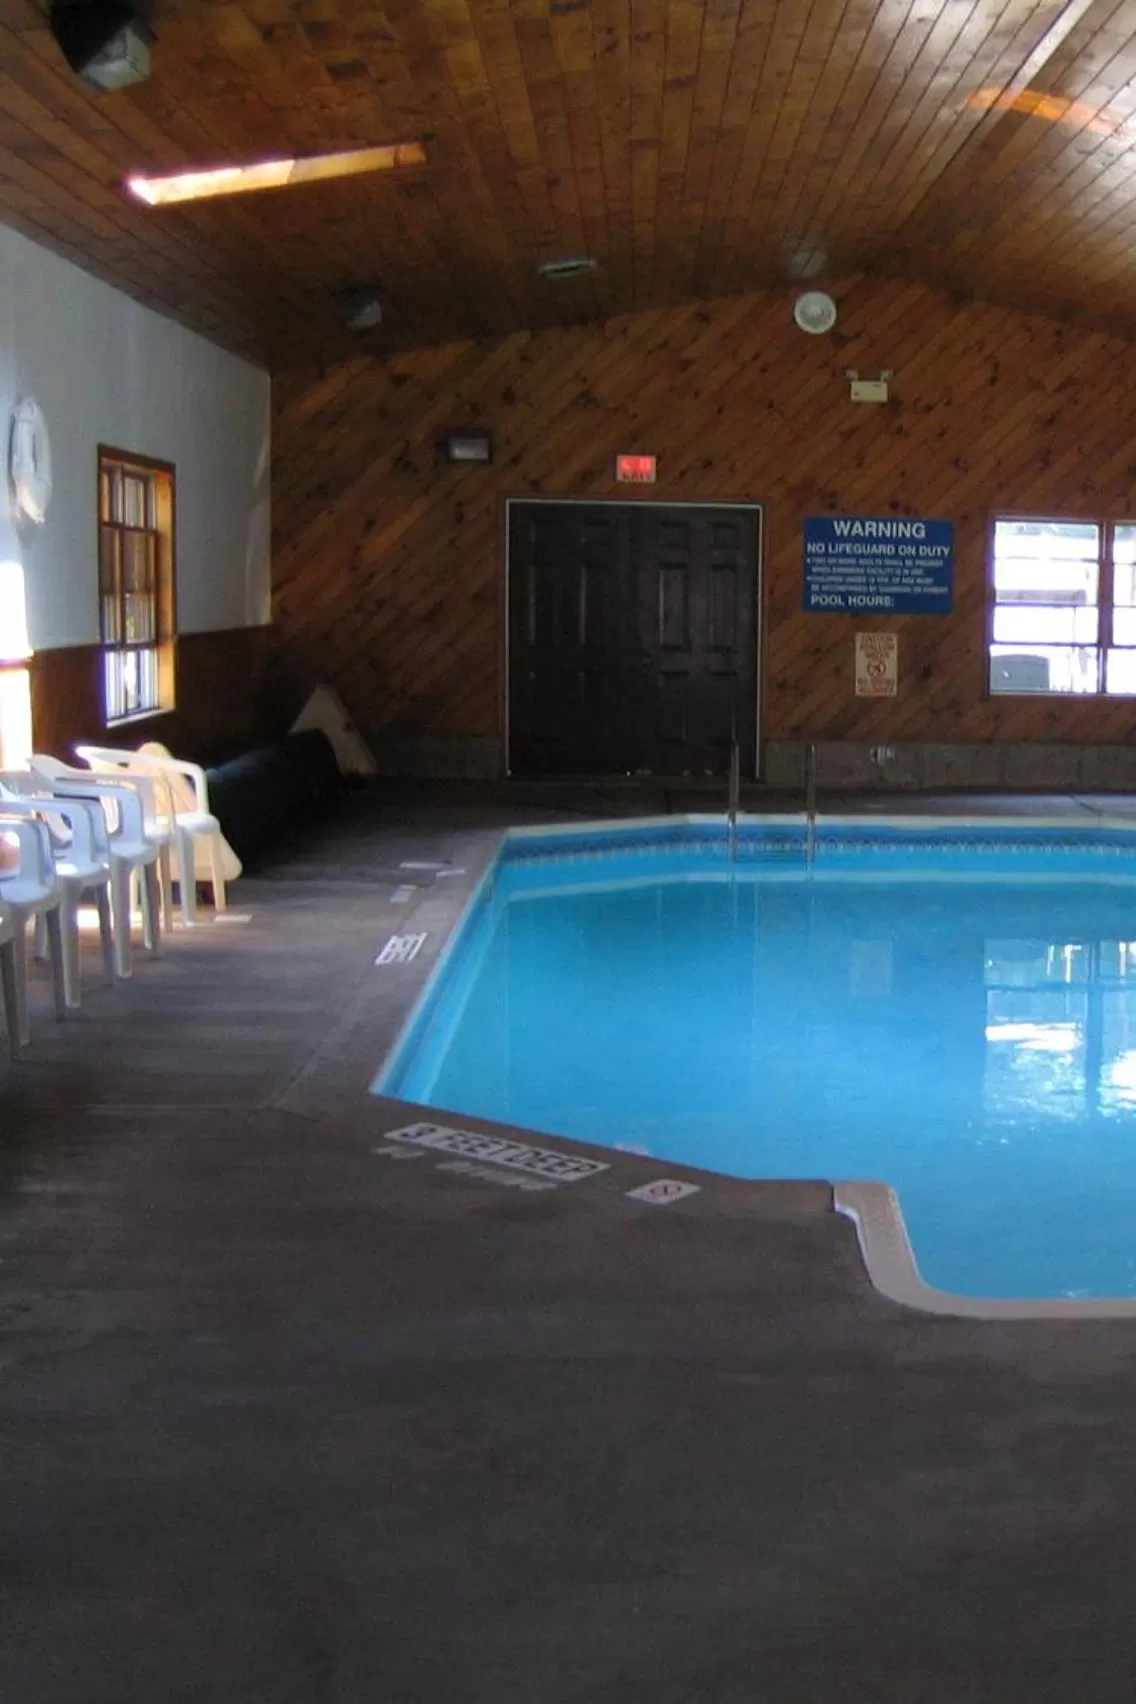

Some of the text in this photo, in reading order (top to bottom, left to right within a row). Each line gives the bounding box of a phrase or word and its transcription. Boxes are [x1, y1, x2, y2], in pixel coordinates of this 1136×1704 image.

[833, 520, 926, 539] WARNING
[806, 542, 951, 557] NO LIFEGUARD ON DUTY
[811, 595, 894, 608] POOL HOURS:
[430, 1131, 521, 1156] FEET
[503, 1148, 600, 1176] DEEP
